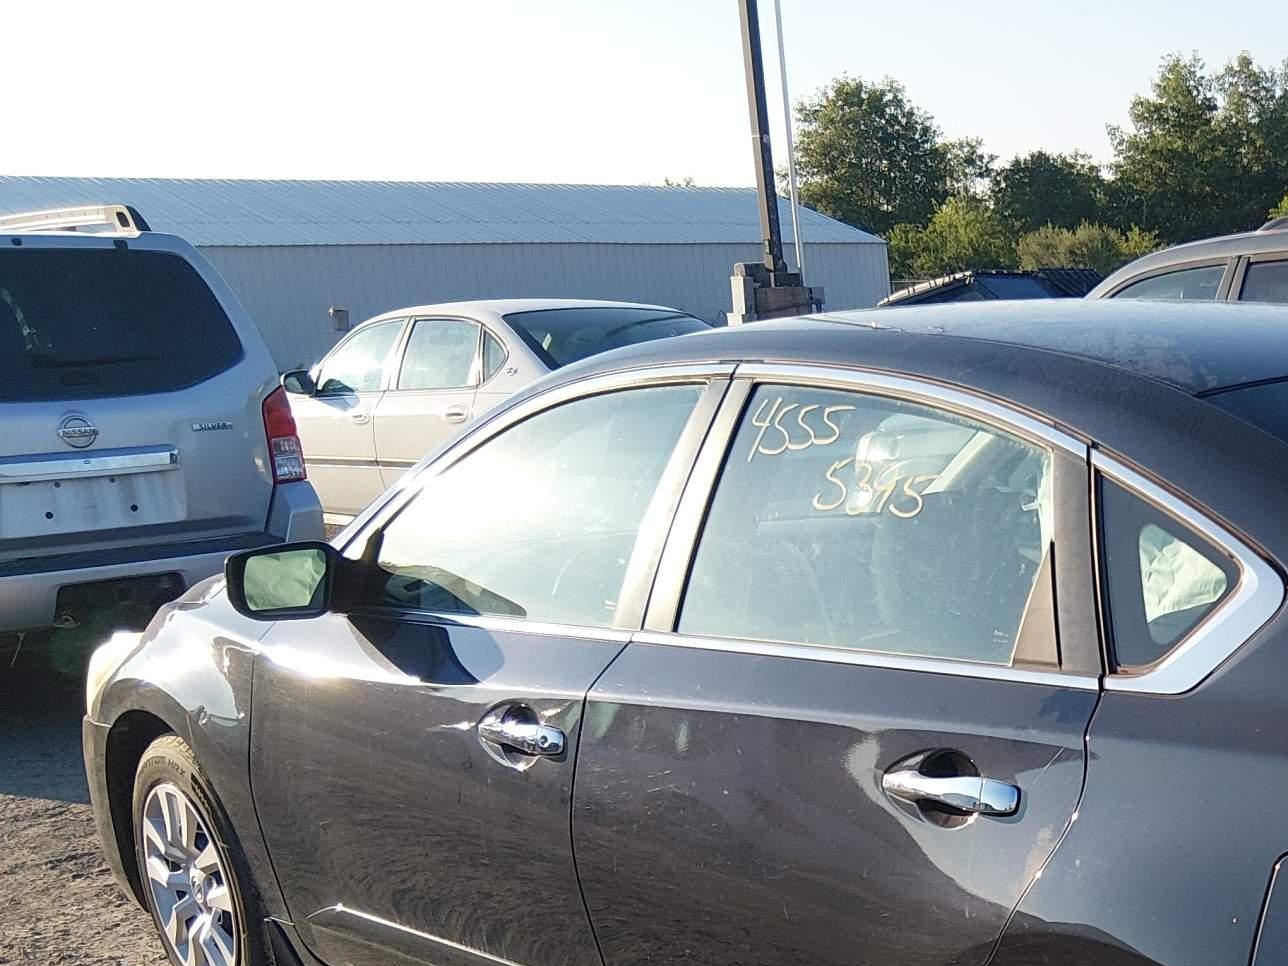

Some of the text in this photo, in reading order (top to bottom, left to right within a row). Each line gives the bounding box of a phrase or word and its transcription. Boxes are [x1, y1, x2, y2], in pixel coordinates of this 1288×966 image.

[62, 427, 97, 438] NISSAN
[748, 397, 856, 462] 4555
[812, 457, 944, 518] 5395
